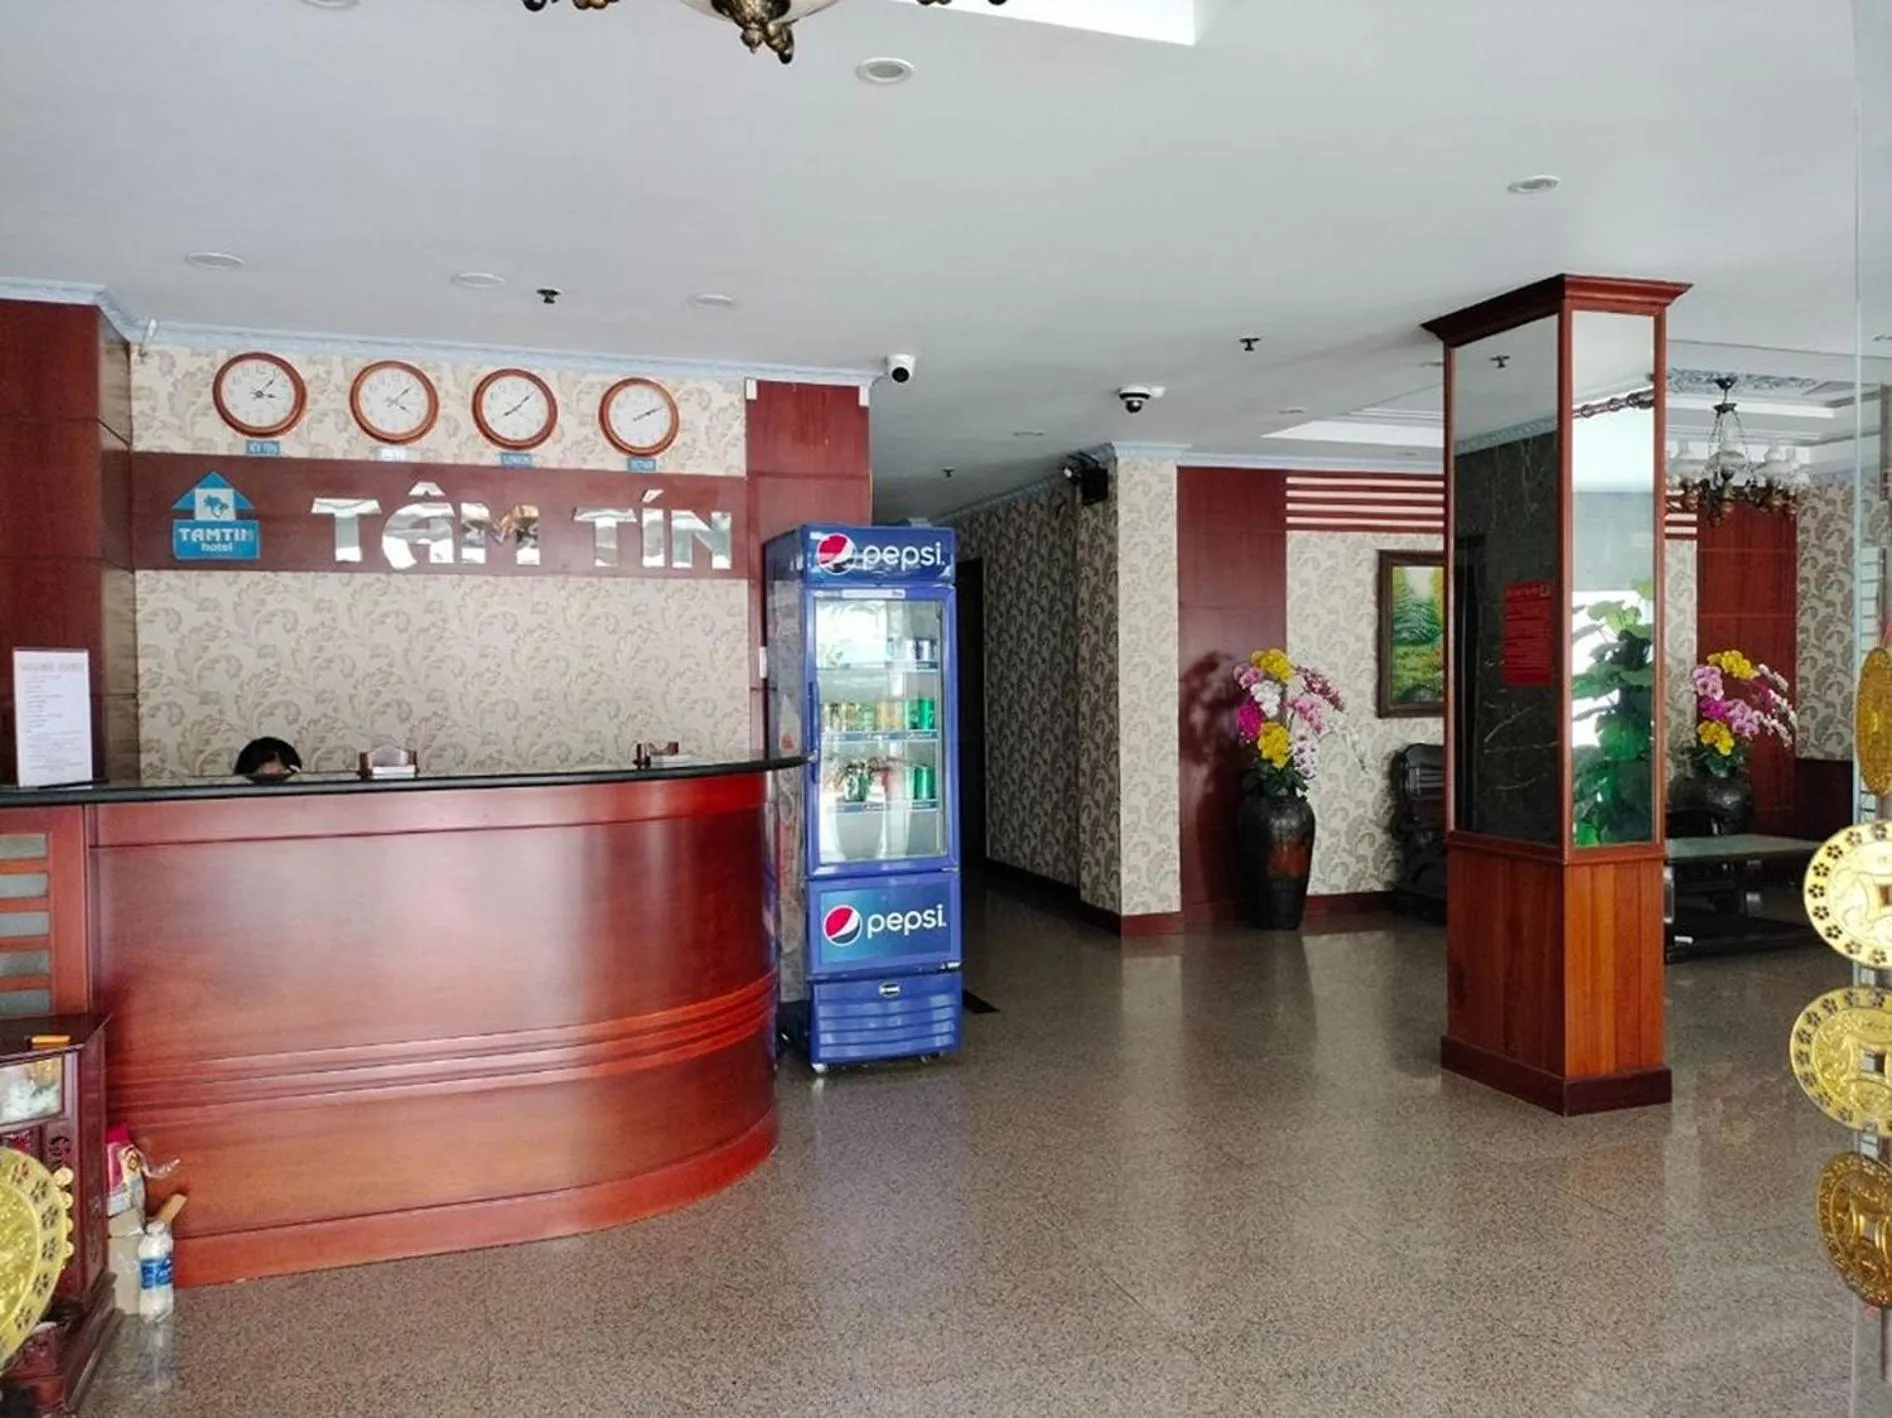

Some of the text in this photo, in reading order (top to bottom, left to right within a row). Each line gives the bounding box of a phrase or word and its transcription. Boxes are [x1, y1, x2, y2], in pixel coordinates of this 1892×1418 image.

[311, 481, 732, 569] TÂM TÍN
[201, 542, 233, 552] hotel
[863, 541, 942, 571] pepsi
[867, 903, 944, 939] pepsi
